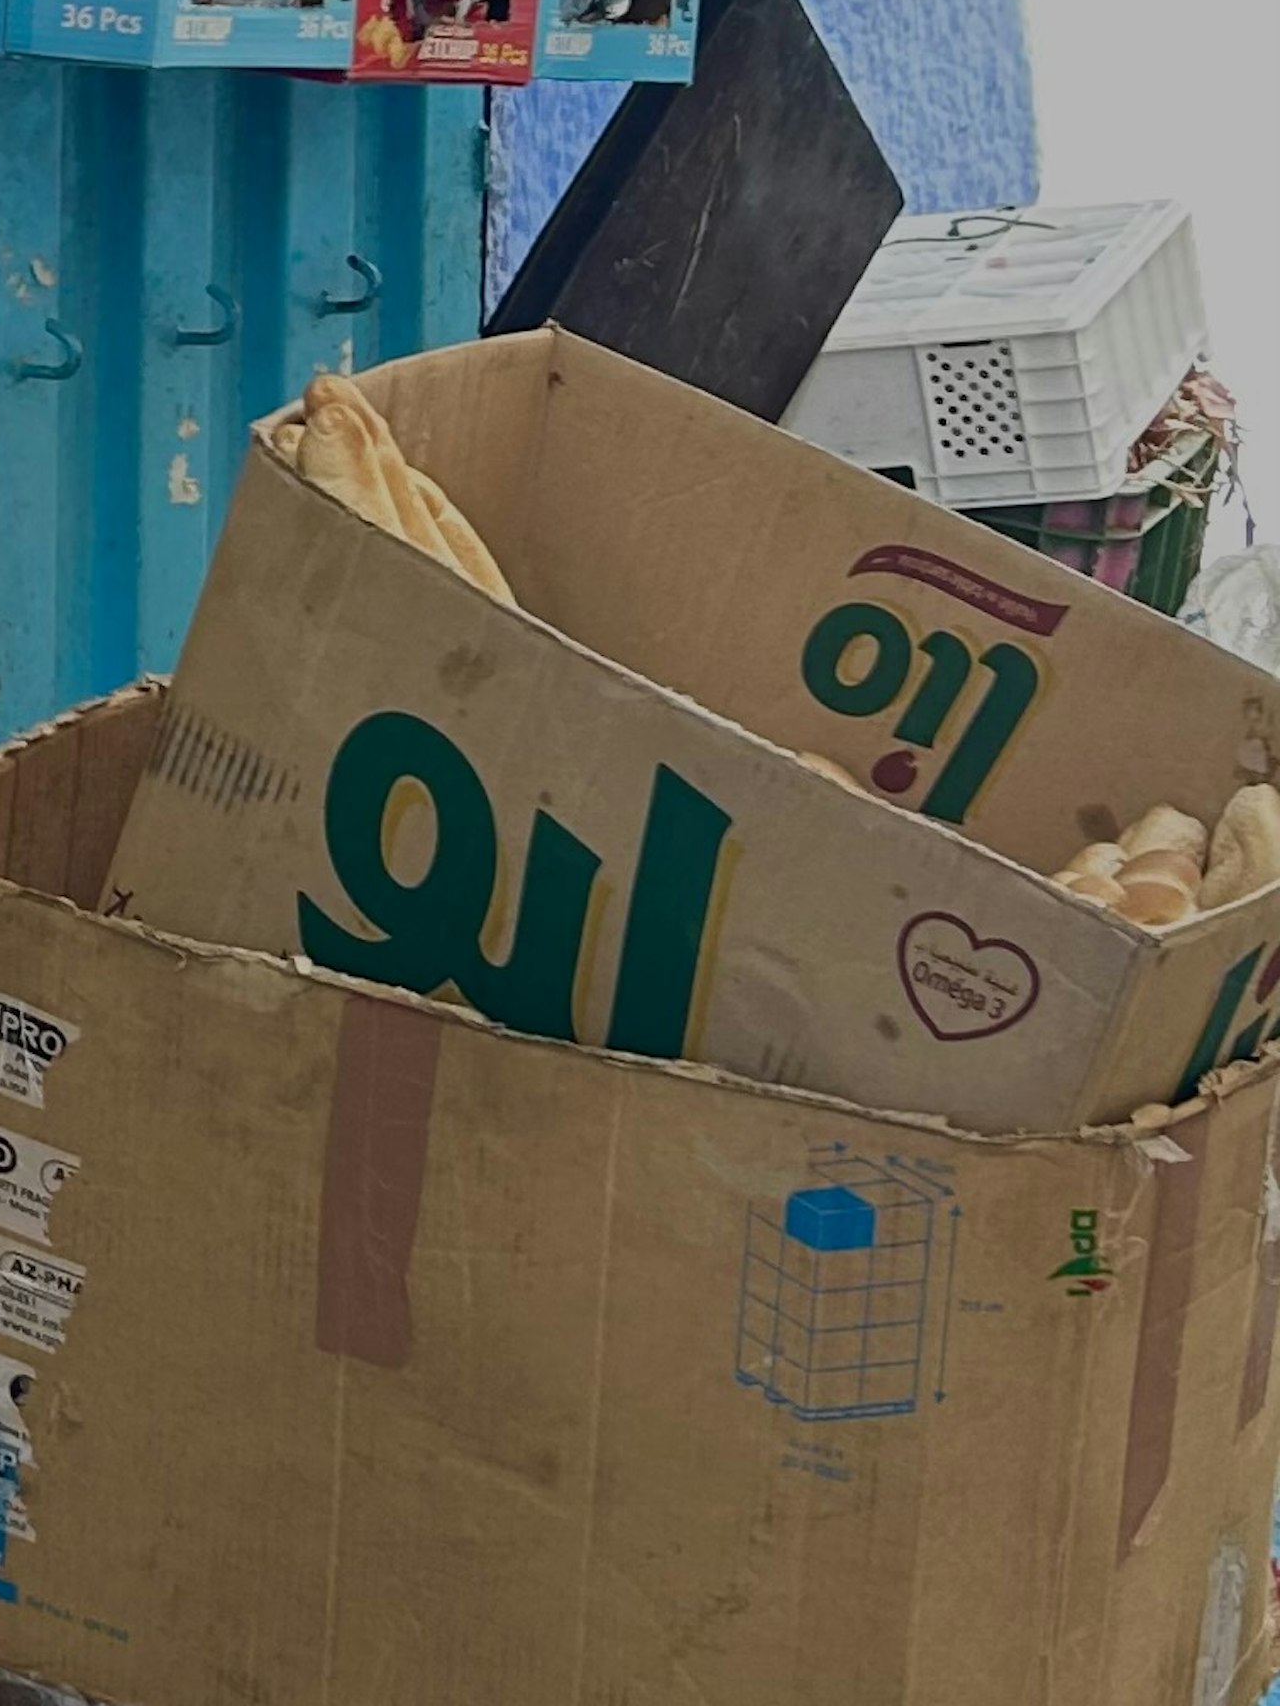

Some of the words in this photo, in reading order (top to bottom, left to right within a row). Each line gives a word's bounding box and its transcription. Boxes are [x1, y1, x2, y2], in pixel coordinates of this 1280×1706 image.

[61, 2, 98, 31] 36
[101, 3, 145, 37] Pcs
[912, 960, 987, 1012] Oméga
[987, 996, 1007, 1019] 3
